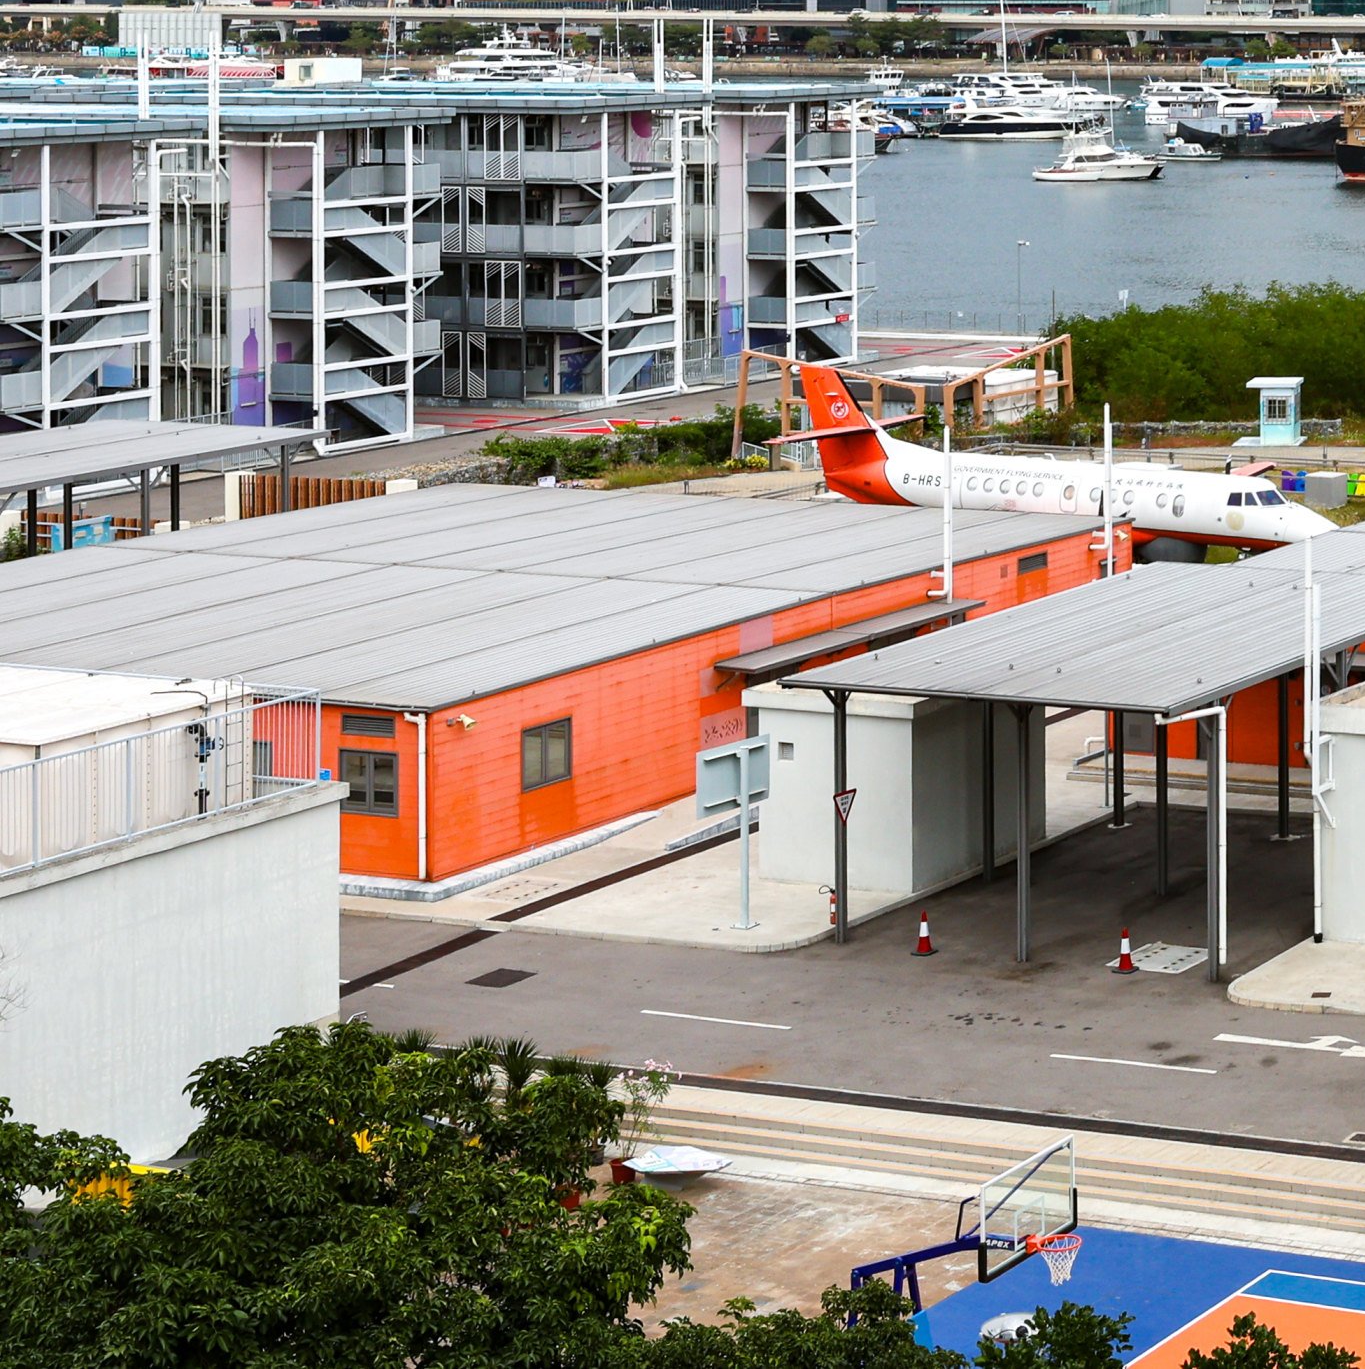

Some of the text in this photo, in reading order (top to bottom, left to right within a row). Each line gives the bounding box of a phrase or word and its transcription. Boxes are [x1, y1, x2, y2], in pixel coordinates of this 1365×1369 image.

[953, 464, 1064, 480] GOVERNMENT FLYING SERVICE
[903, 473, 941, 487] B-HRS
[985, 1239, 1010, 1249] APEX
